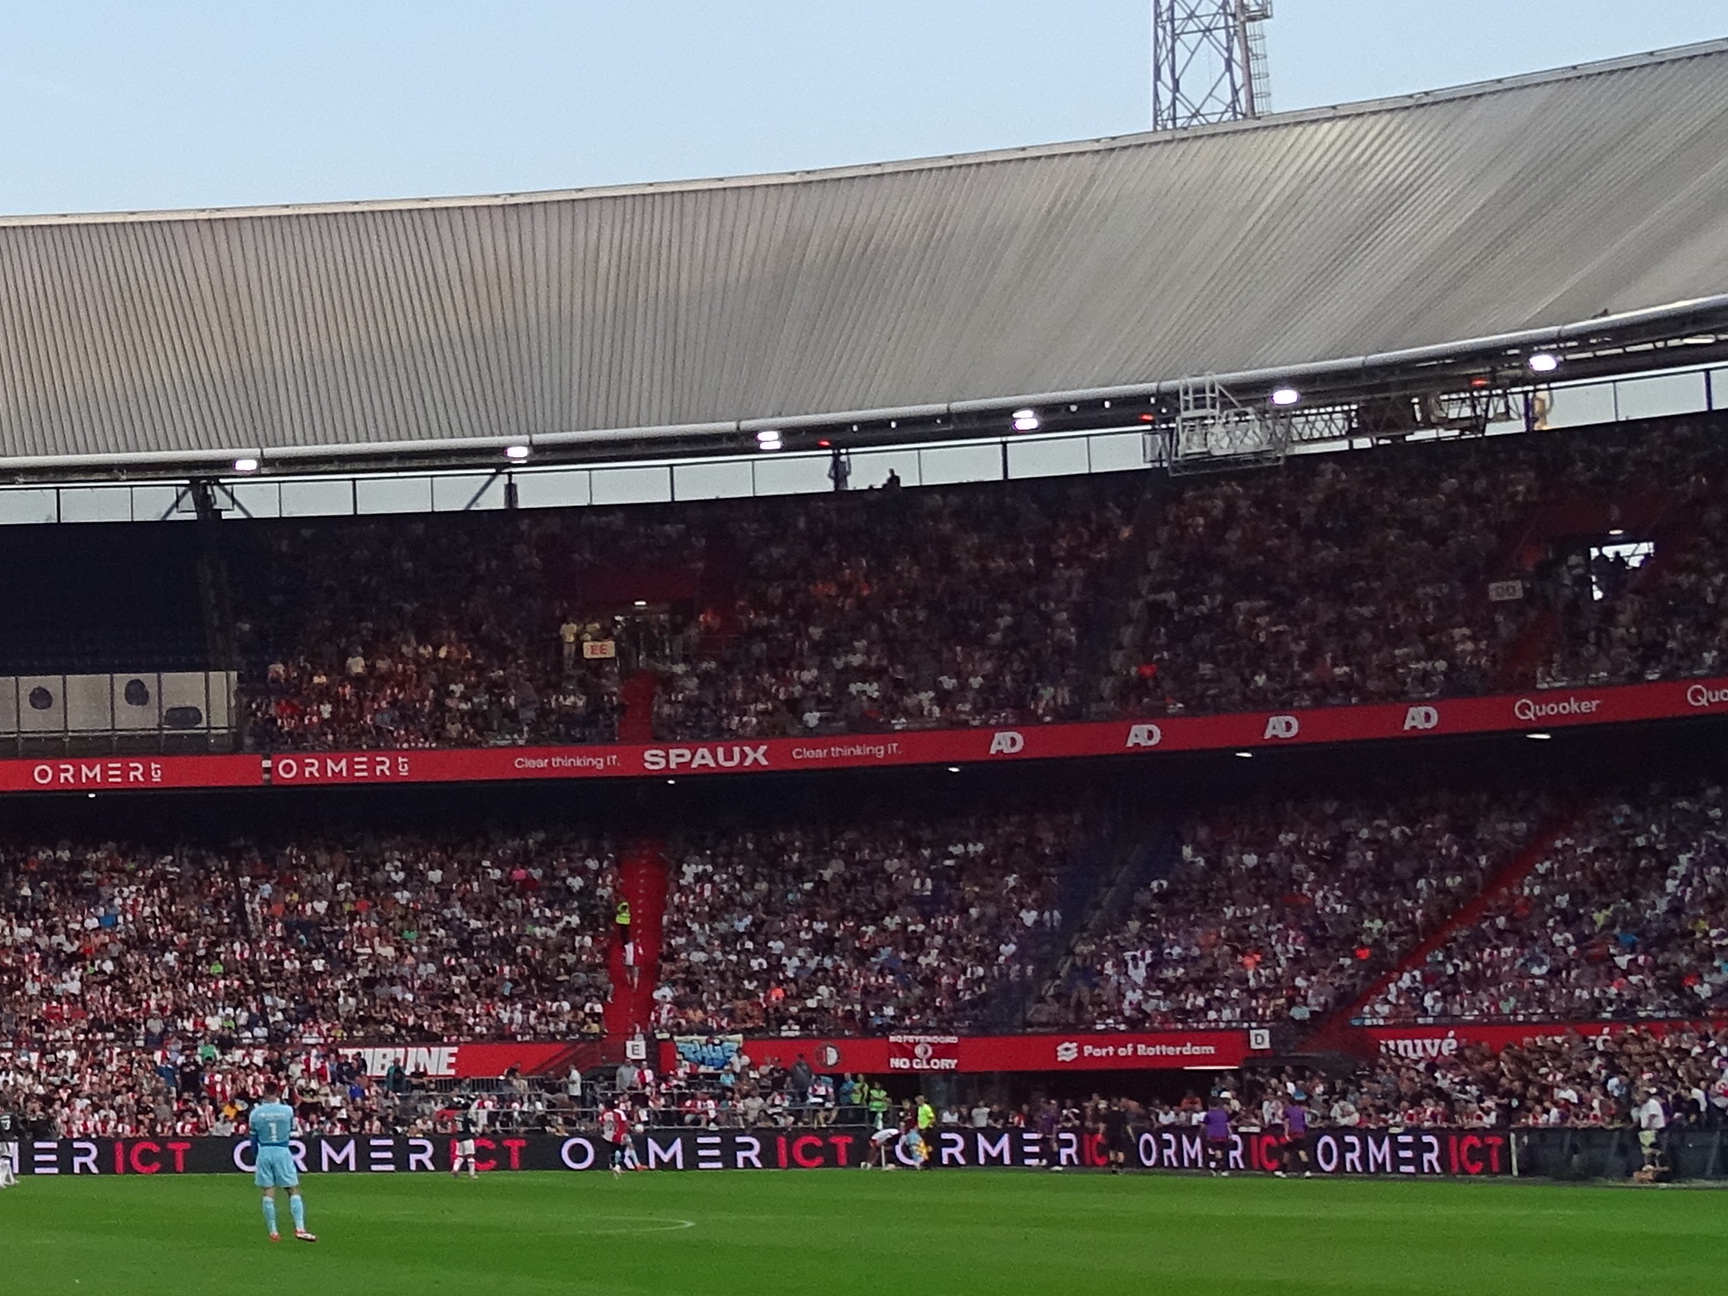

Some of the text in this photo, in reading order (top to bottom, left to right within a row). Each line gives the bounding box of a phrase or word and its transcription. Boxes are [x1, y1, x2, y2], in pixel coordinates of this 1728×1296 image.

[1404, 706, 1438, 730] AD
[1514, 697, 1600, 720] Quooker
[1126, 724, 1161, 747] AD
[1264, 716, 1299, 739] AD
[792, 747, 829, 759] Clear
[831, 745, 885, 758] thinking
[990, 731, 1024, 754] AD
[278, 757, 390, 778] ORMER
[514, 757, 549, 769] Clear
[551, 755, 604, 770] thinking
[643, 745, 769, 769] SPAUX
[33, 762, 144, 784] ORMER
[1083, 1042, 1215, 1057] Port of Rotterdam
[889, 1057, 958, 1070] NO GLORY
[268, 1122, 277, 1142] 1
